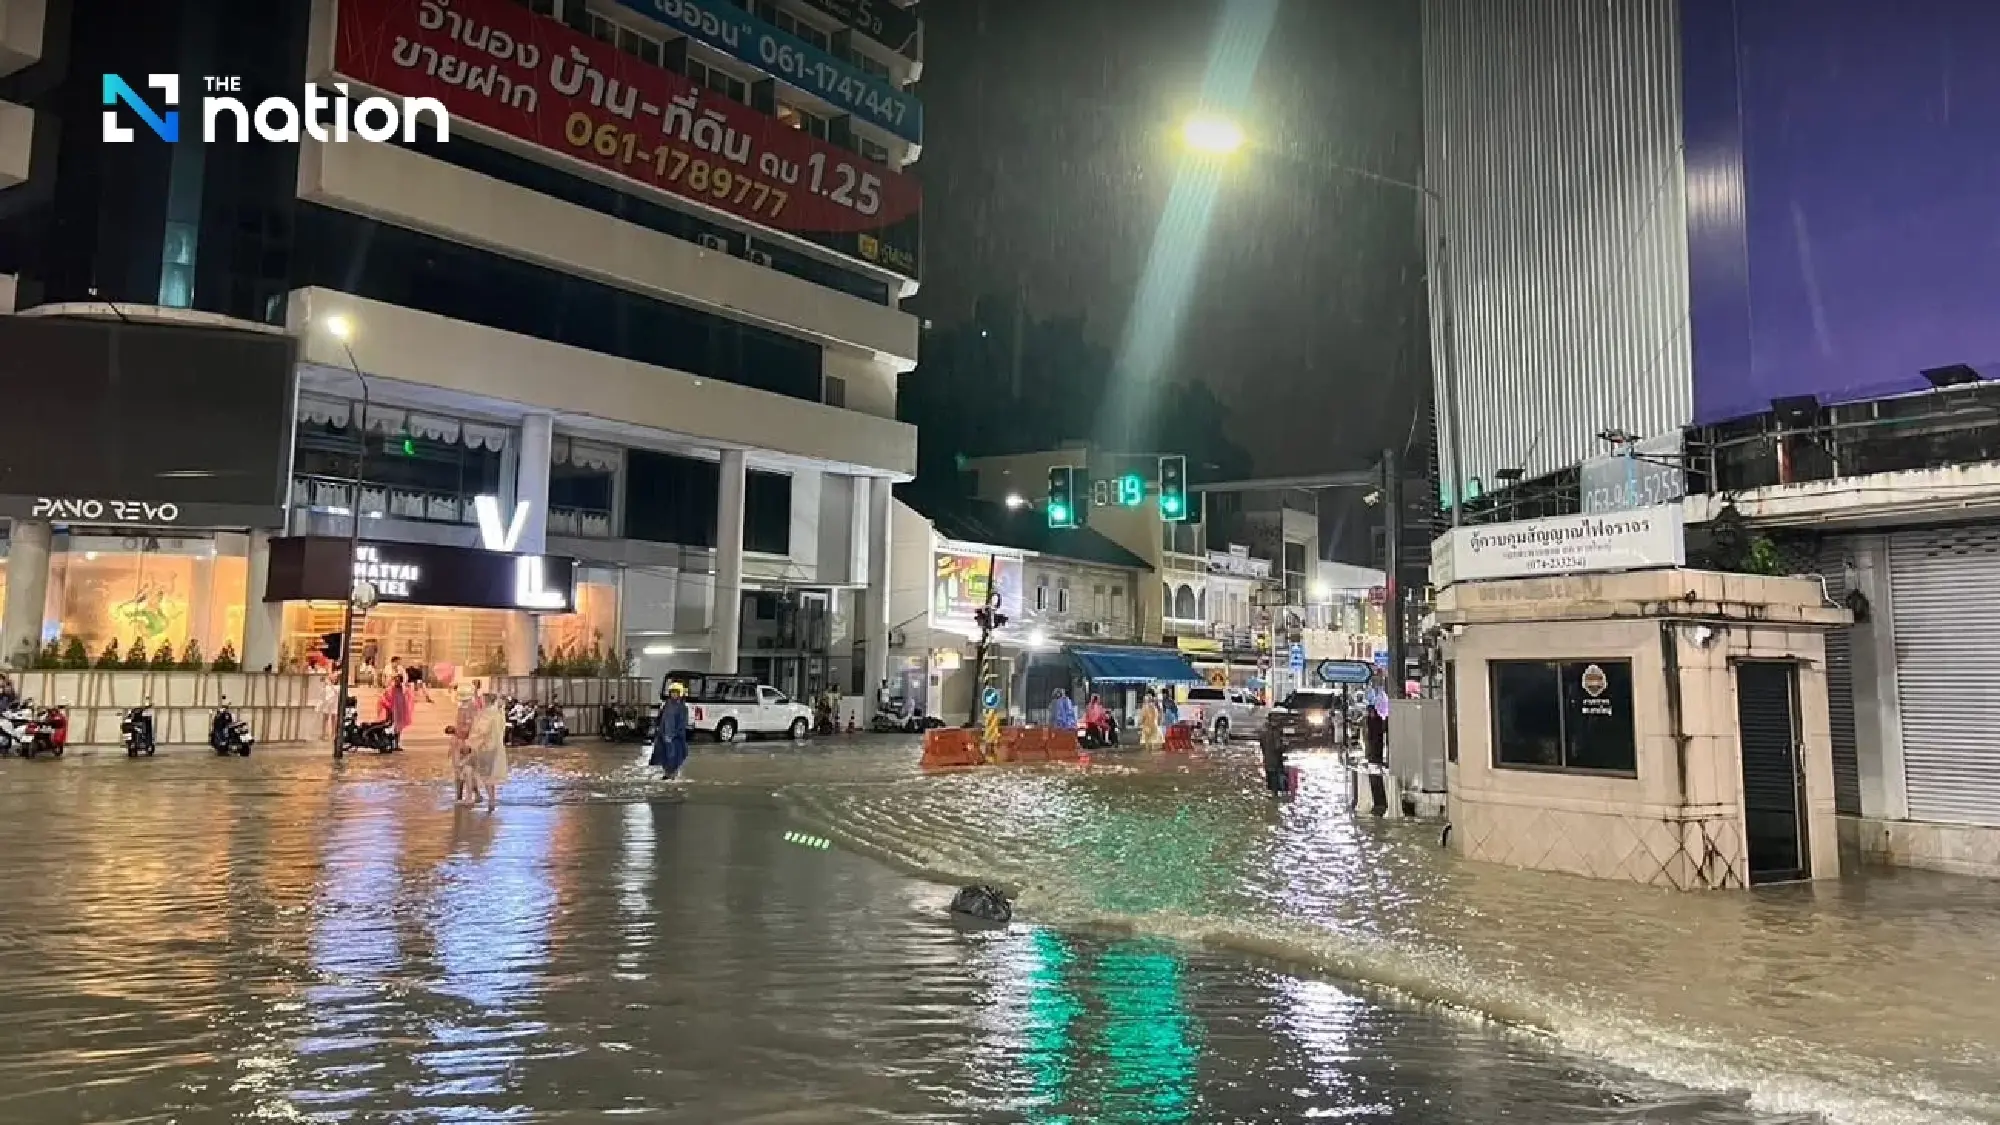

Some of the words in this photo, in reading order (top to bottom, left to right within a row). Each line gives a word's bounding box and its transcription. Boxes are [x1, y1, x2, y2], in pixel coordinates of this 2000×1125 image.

[391, 36, 539, 113] ขายฝาก
[759, 35, 907, 126] 061-1747447
[549, 45, 752, 165] บ้าน-ที่ดิน
[807, 152, 881, 216] 1.25
[565, 111, 789, 219] 061-1789777
[31, 498, 103, 518] PANO
[109, 501, 179, 521] REVO
[353, 562, 420, 581] HATYAI
[355, 545, 379, 563] VL
